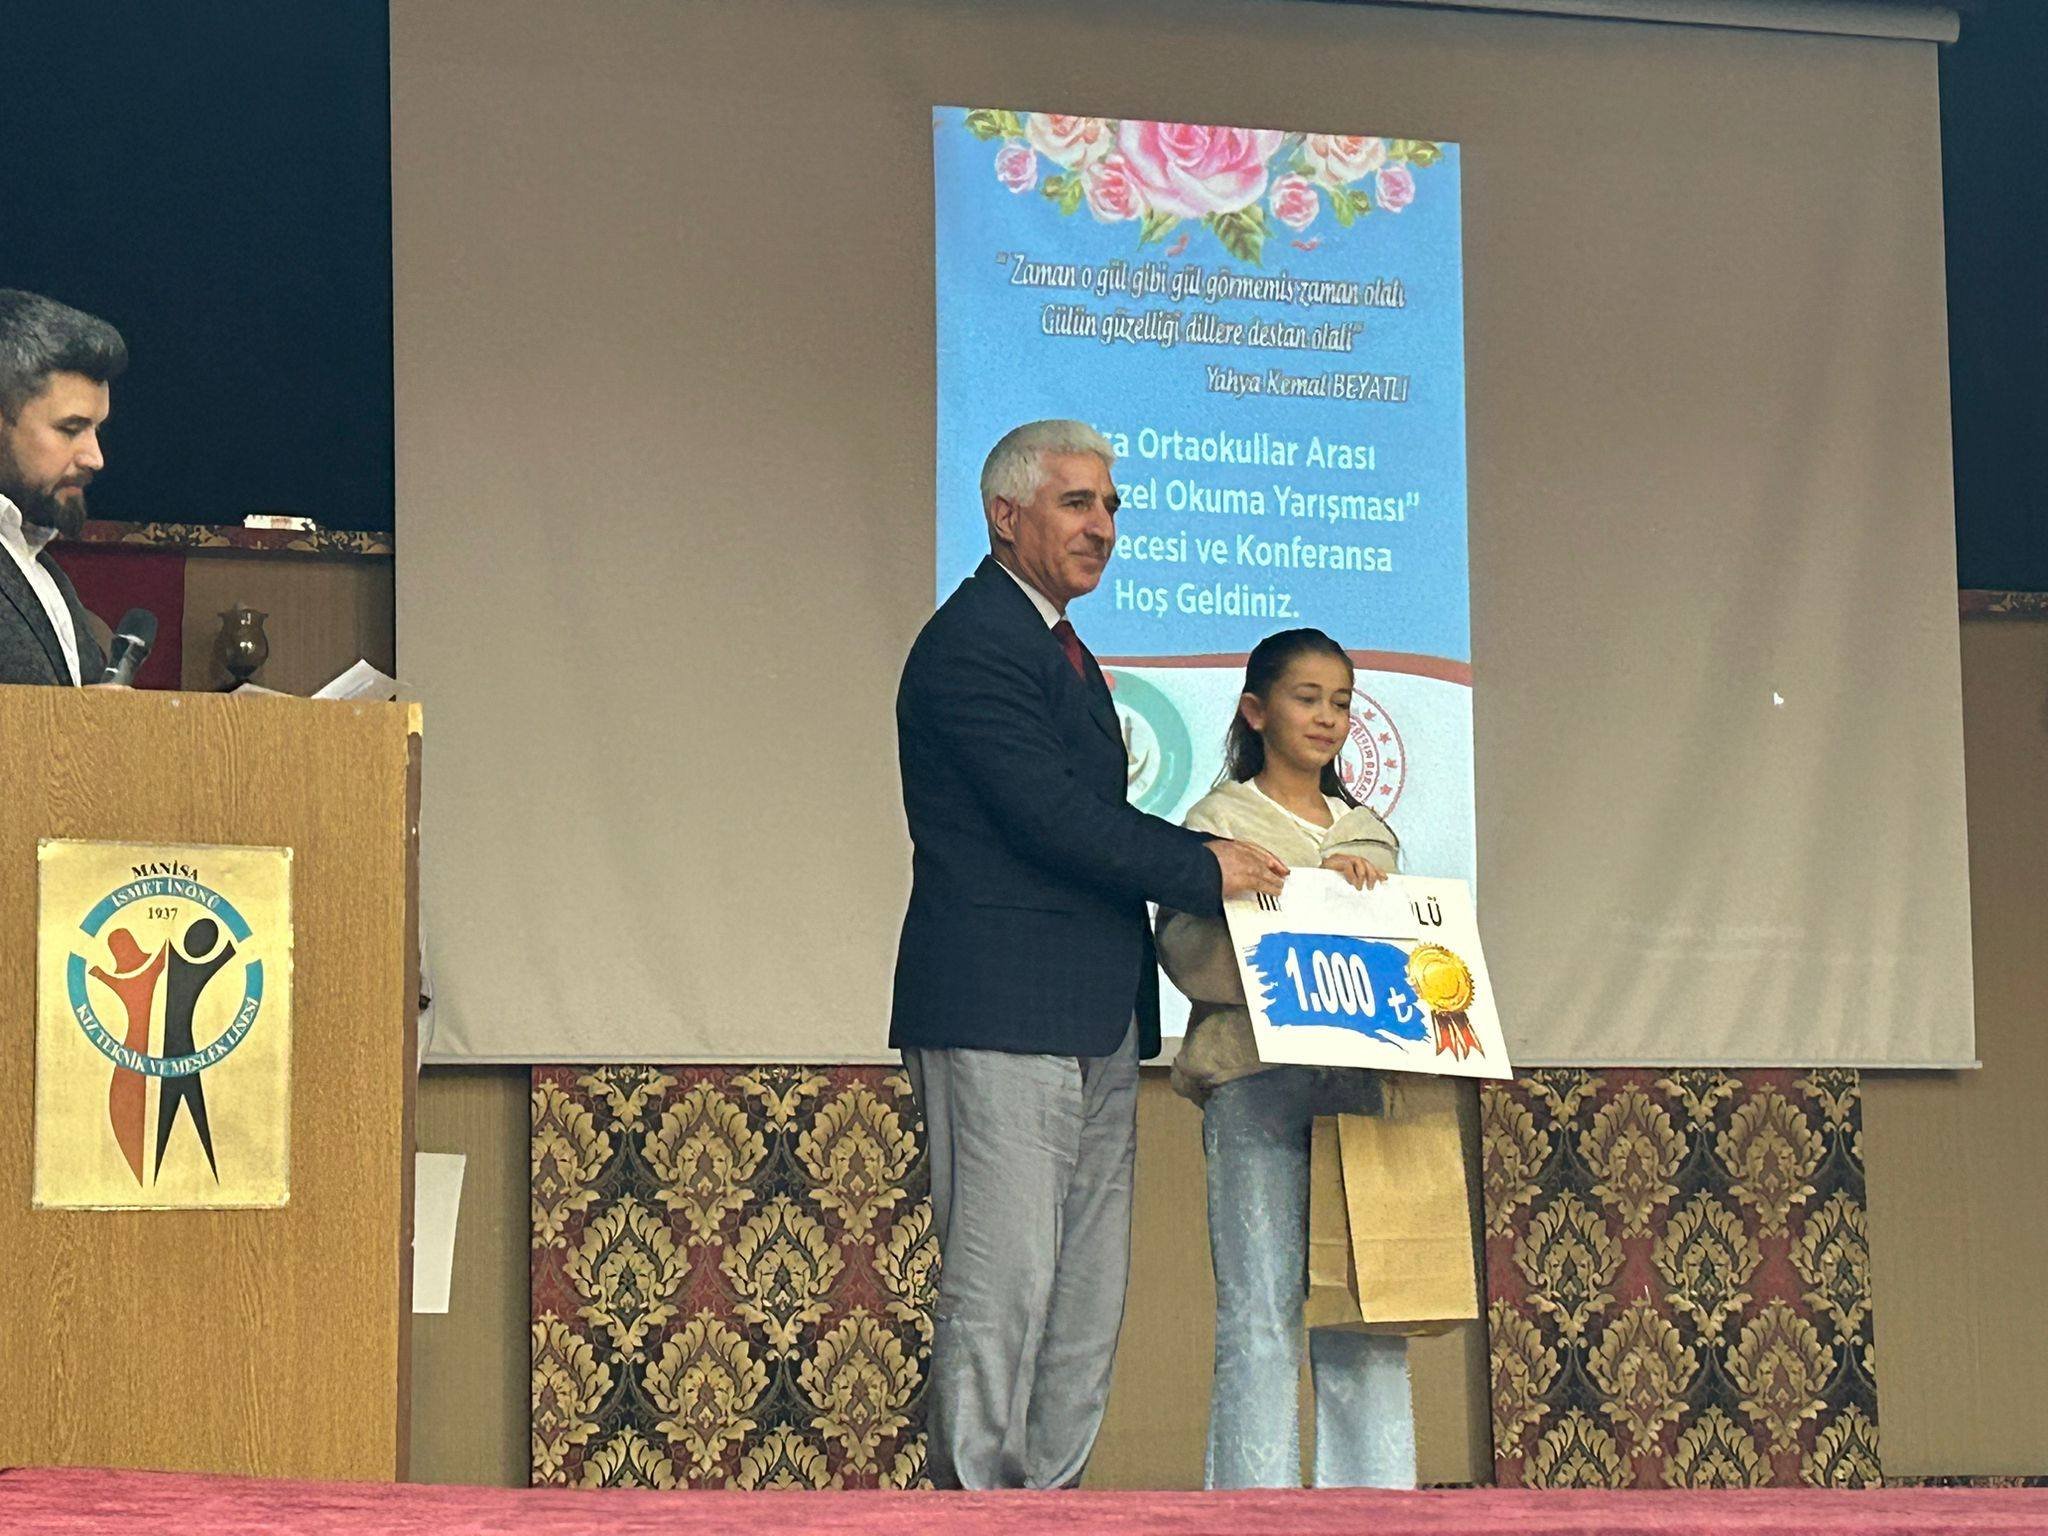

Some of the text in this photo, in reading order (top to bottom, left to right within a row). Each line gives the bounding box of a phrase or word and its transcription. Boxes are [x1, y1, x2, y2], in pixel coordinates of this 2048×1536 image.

[1081, 266, 1092, 288] o
[1096, 259, 1126, 297] gül
[1131, 262, 1166, 299] gibi
[1171, 265, 1201, 301] gül
[1298, 280, 1359, 307] zaman
[1042, 303, 1097, 336] Gülün
[1185, 312, 1243, 345] dillere
[1248, 319, 1306, 348] destan
[1206, 366, 1409, 402] Yahya Kemal BEYATLI
[1137, 427, 1298, 467] Ortaokullar
[1306, 437, 1375, 470] Arası
[1116, 477, 1157, 510] zel
[1166, 479, 1265, 515] Okuma
[1115, 531, 1393, 573] ecesi ve Konferansa
[1115, 578, 1300, 619] Hoş Geldiniz.
[147, 906, 178, 921] 1937
[1285, 946, 1377, 1018] 1.000
